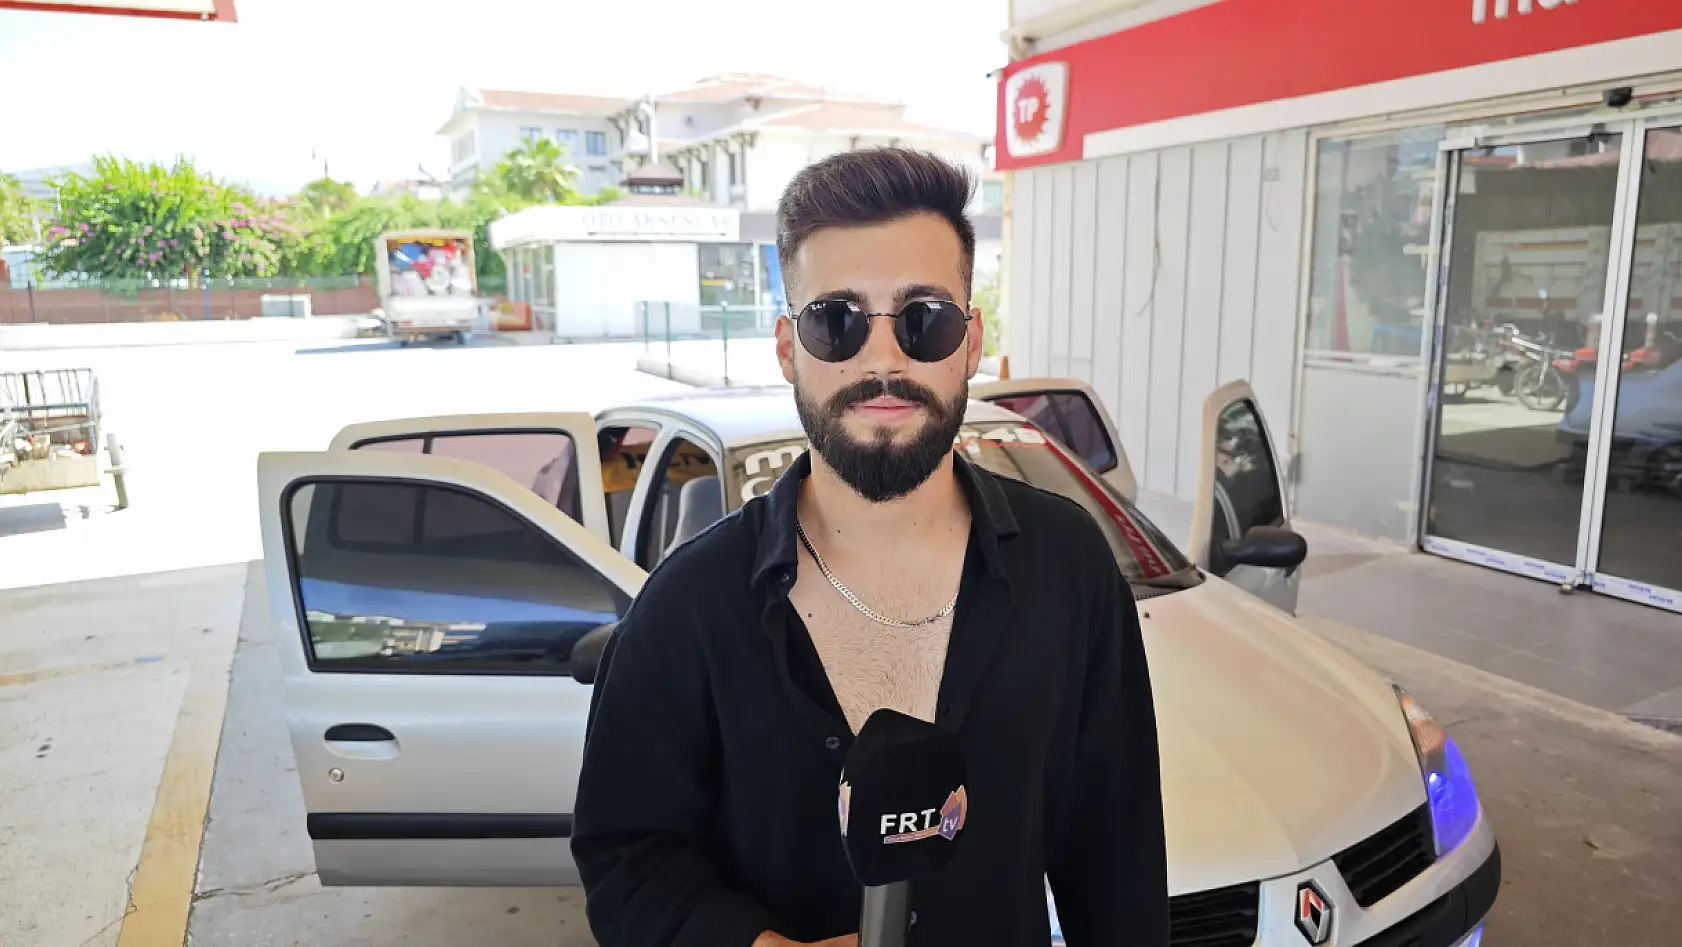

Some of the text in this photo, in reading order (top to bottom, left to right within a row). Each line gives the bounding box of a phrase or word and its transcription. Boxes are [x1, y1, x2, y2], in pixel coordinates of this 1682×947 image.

[1018, 96, 1040, 124] TP
[880, 807, 960, 835] FRT tv
